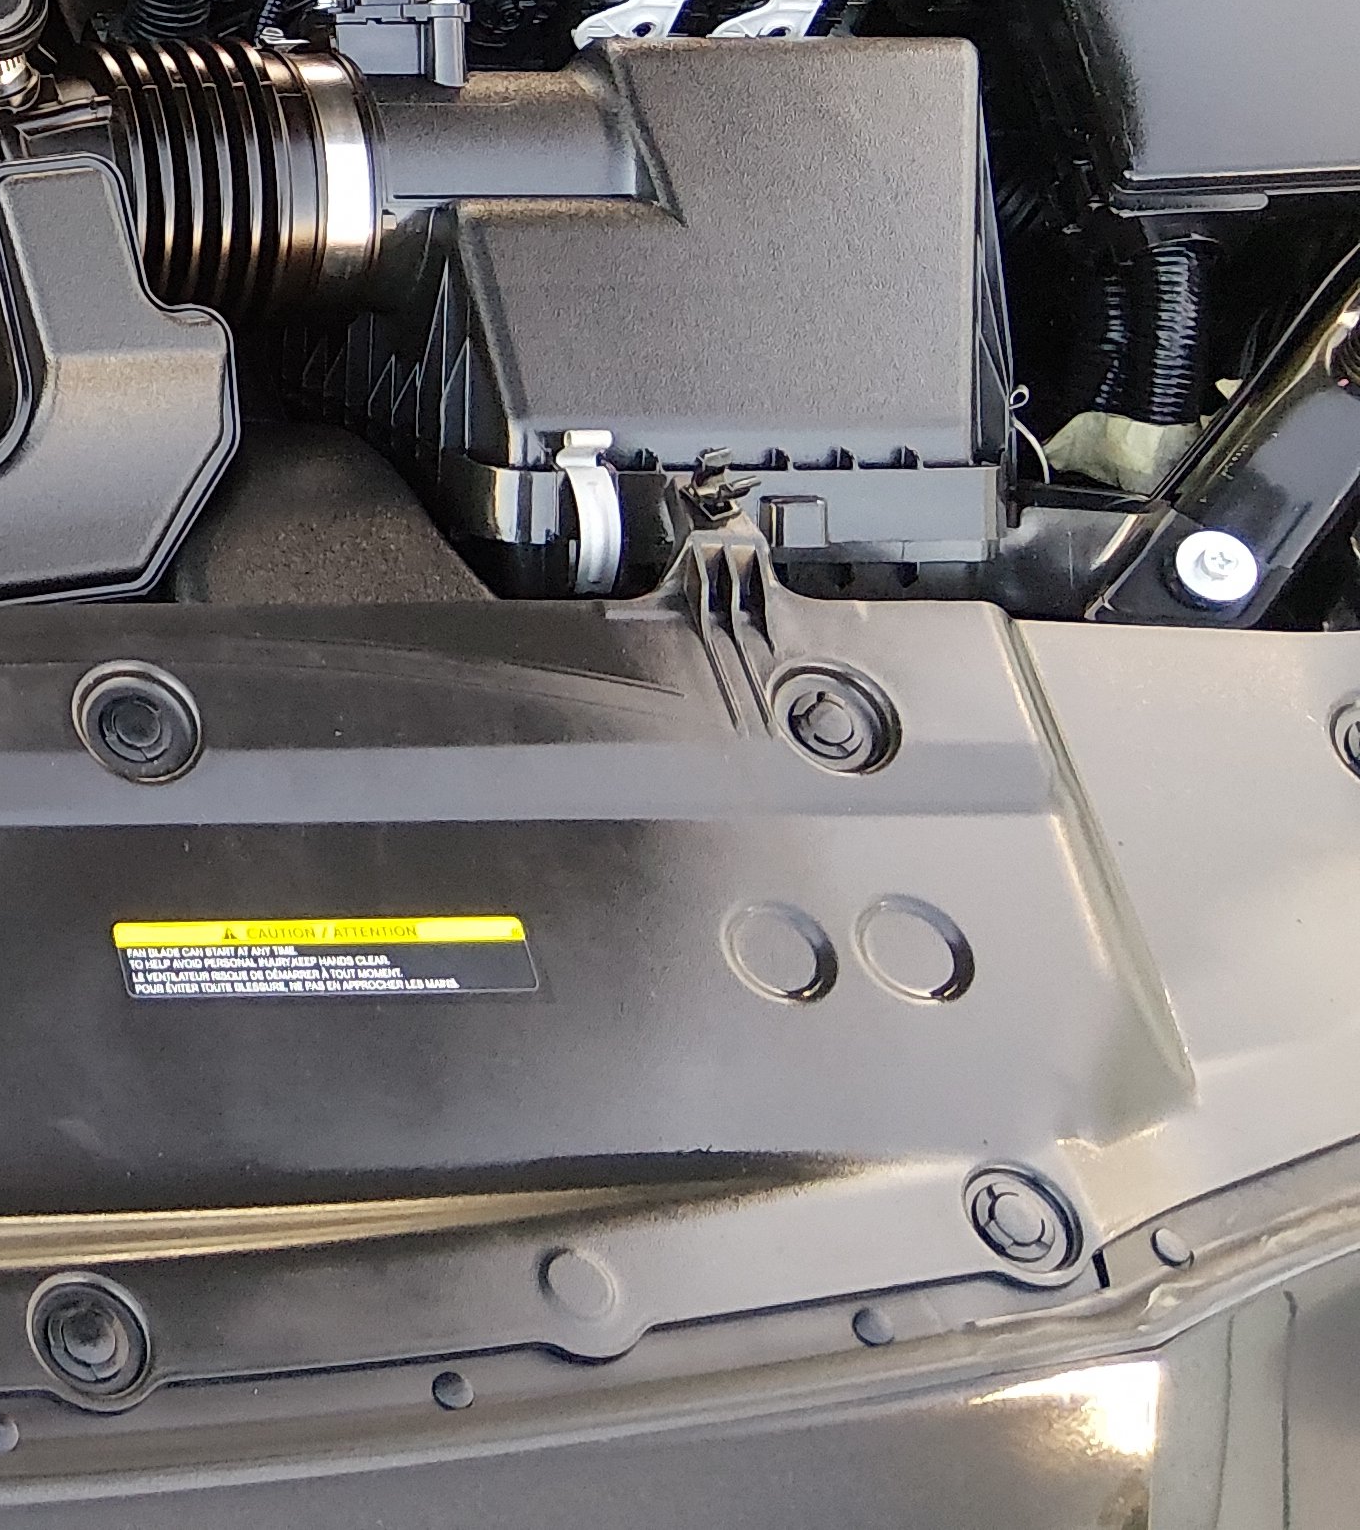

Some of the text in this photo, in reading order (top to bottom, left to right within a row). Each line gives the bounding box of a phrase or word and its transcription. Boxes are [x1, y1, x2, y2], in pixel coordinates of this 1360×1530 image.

[246, 927, 316, 940] CAUTION
[334, 925, 417, 938] ATTENTION
[127, 948, 146, 958] FAN
[148, 947, 181, 958] BLADE
[182, 947, 203, 957] CAN
[205, 947, 234, 956] START
[238, 946, 248, 956] AT
[251, 946, 270, 956] ANY
[129, 959, 143, 969] TO
[145, 959, 170, 969] HELP
[173, 958, 202, 969] AVOID
[204, 958, 257, 968] PERSONAL
[318, 955, 354, 966] HANDS
[355, 955, 390, 966] CLEAR.
[132, 972, 145, 982] LE
[146, 971, 210, 982] VENTILATEUR
[211, 970, 248, 980] RISQUE
[250, 970, 264, 980] DE
[265, 968, 320, 980] DÉMARRER
[330, 968, 355, 979] TOUT
[357, 967, 403, 978] MOMENT.
[135, 983, 164, 994] POUR
[166, 982, 199, 993] ÉVITER
[201, 982, 233, 993] TOUTE
[289, 981, 304, 991] NE
[305, 980, 325, 991] PAS
[326, 980, 341, 991] EN
[343, 979, 404, 990] APPROCHER
[405, 979, 424, 989] LES
